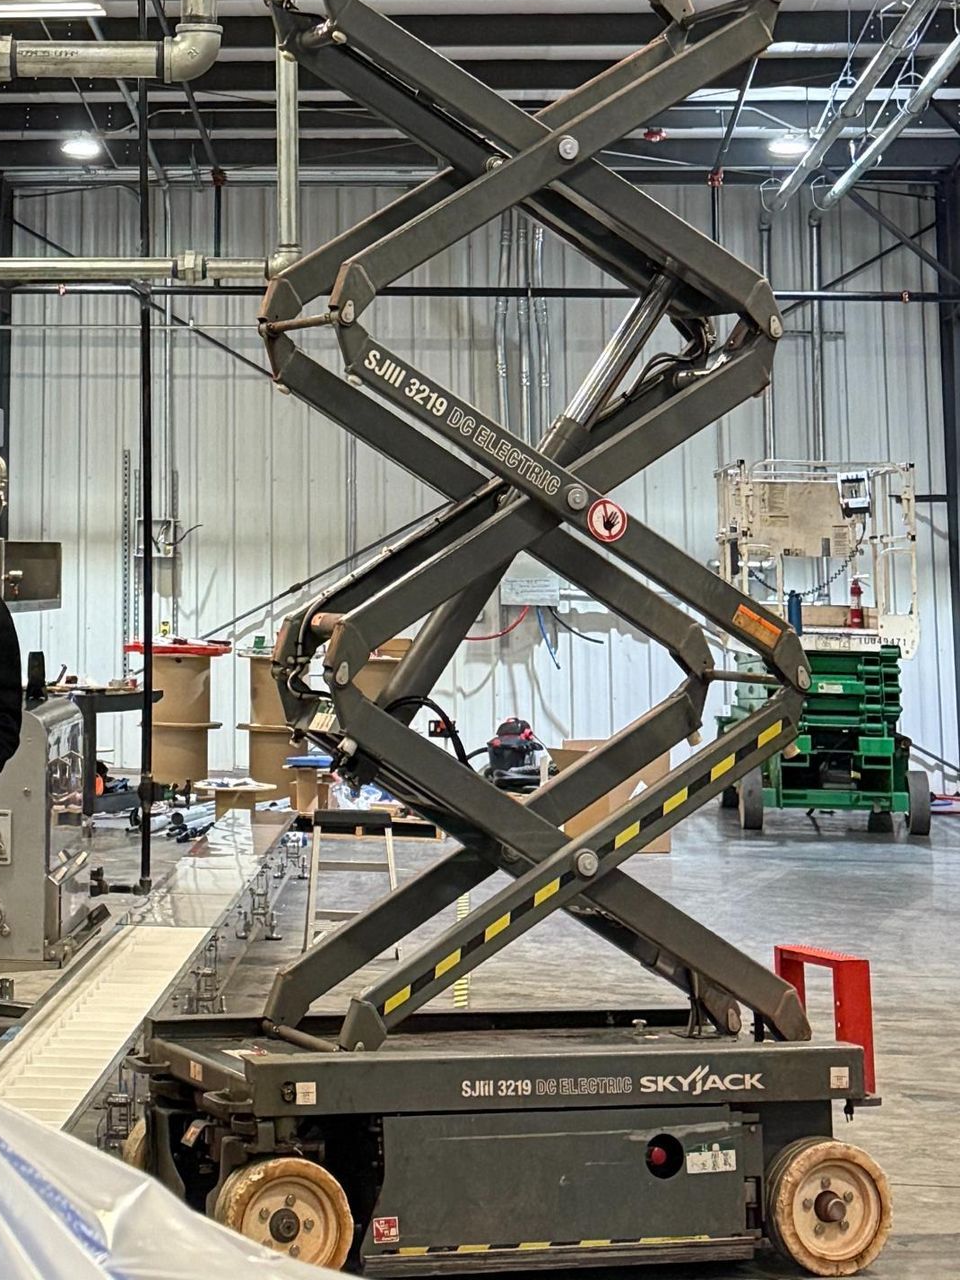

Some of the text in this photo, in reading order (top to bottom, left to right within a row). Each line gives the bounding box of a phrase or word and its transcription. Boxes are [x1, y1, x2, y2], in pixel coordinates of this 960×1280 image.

[363, 349, 562, 496] SJIII 3219 DC ELECTRIC
[497, 1079, 532, 1096] 3219
[535, 1078, 557, 1095] DC
[558, 1076, 633, 1095] ELECTRIC
[639, 1064, 766, 1096] SKYJACK
